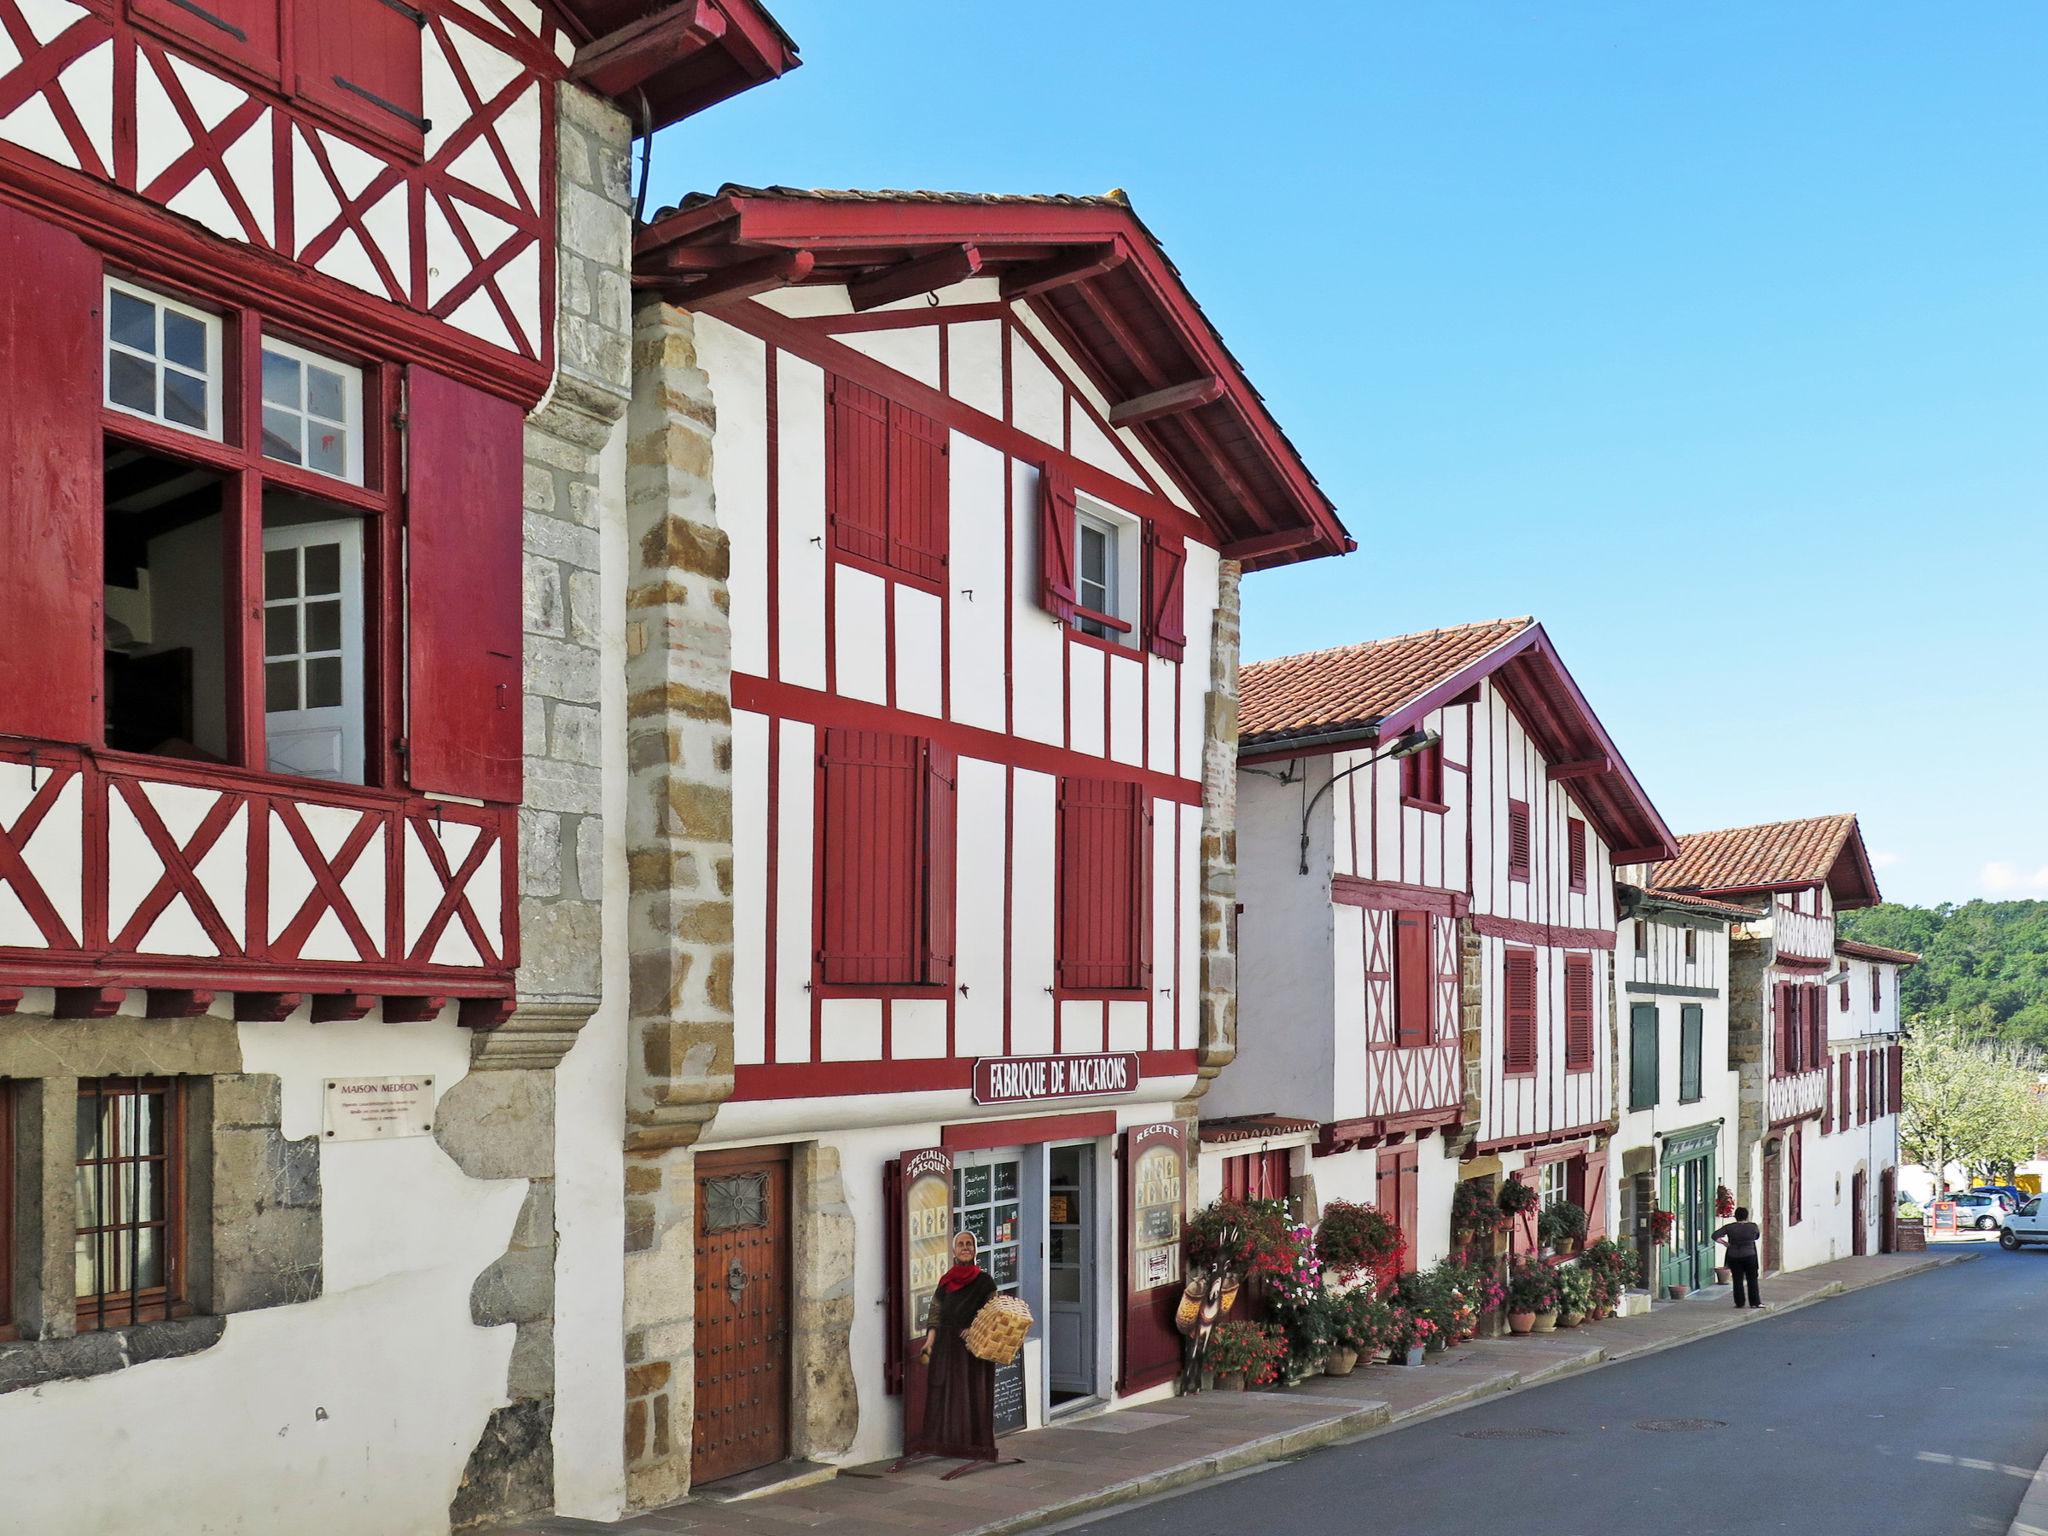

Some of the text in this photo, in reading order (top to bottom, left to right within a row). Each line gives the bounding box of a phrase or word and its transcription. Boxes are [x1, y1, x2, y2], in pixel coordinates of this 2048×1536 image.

[990, 1057, 1126, 1099] FABRIQUE DE MACARONS
[341, 1084, 378, 1094] MAISON
[1136, 1124, 1180, 1144] RECETTE
[912, 1160, 946, 1178] BASQUE
